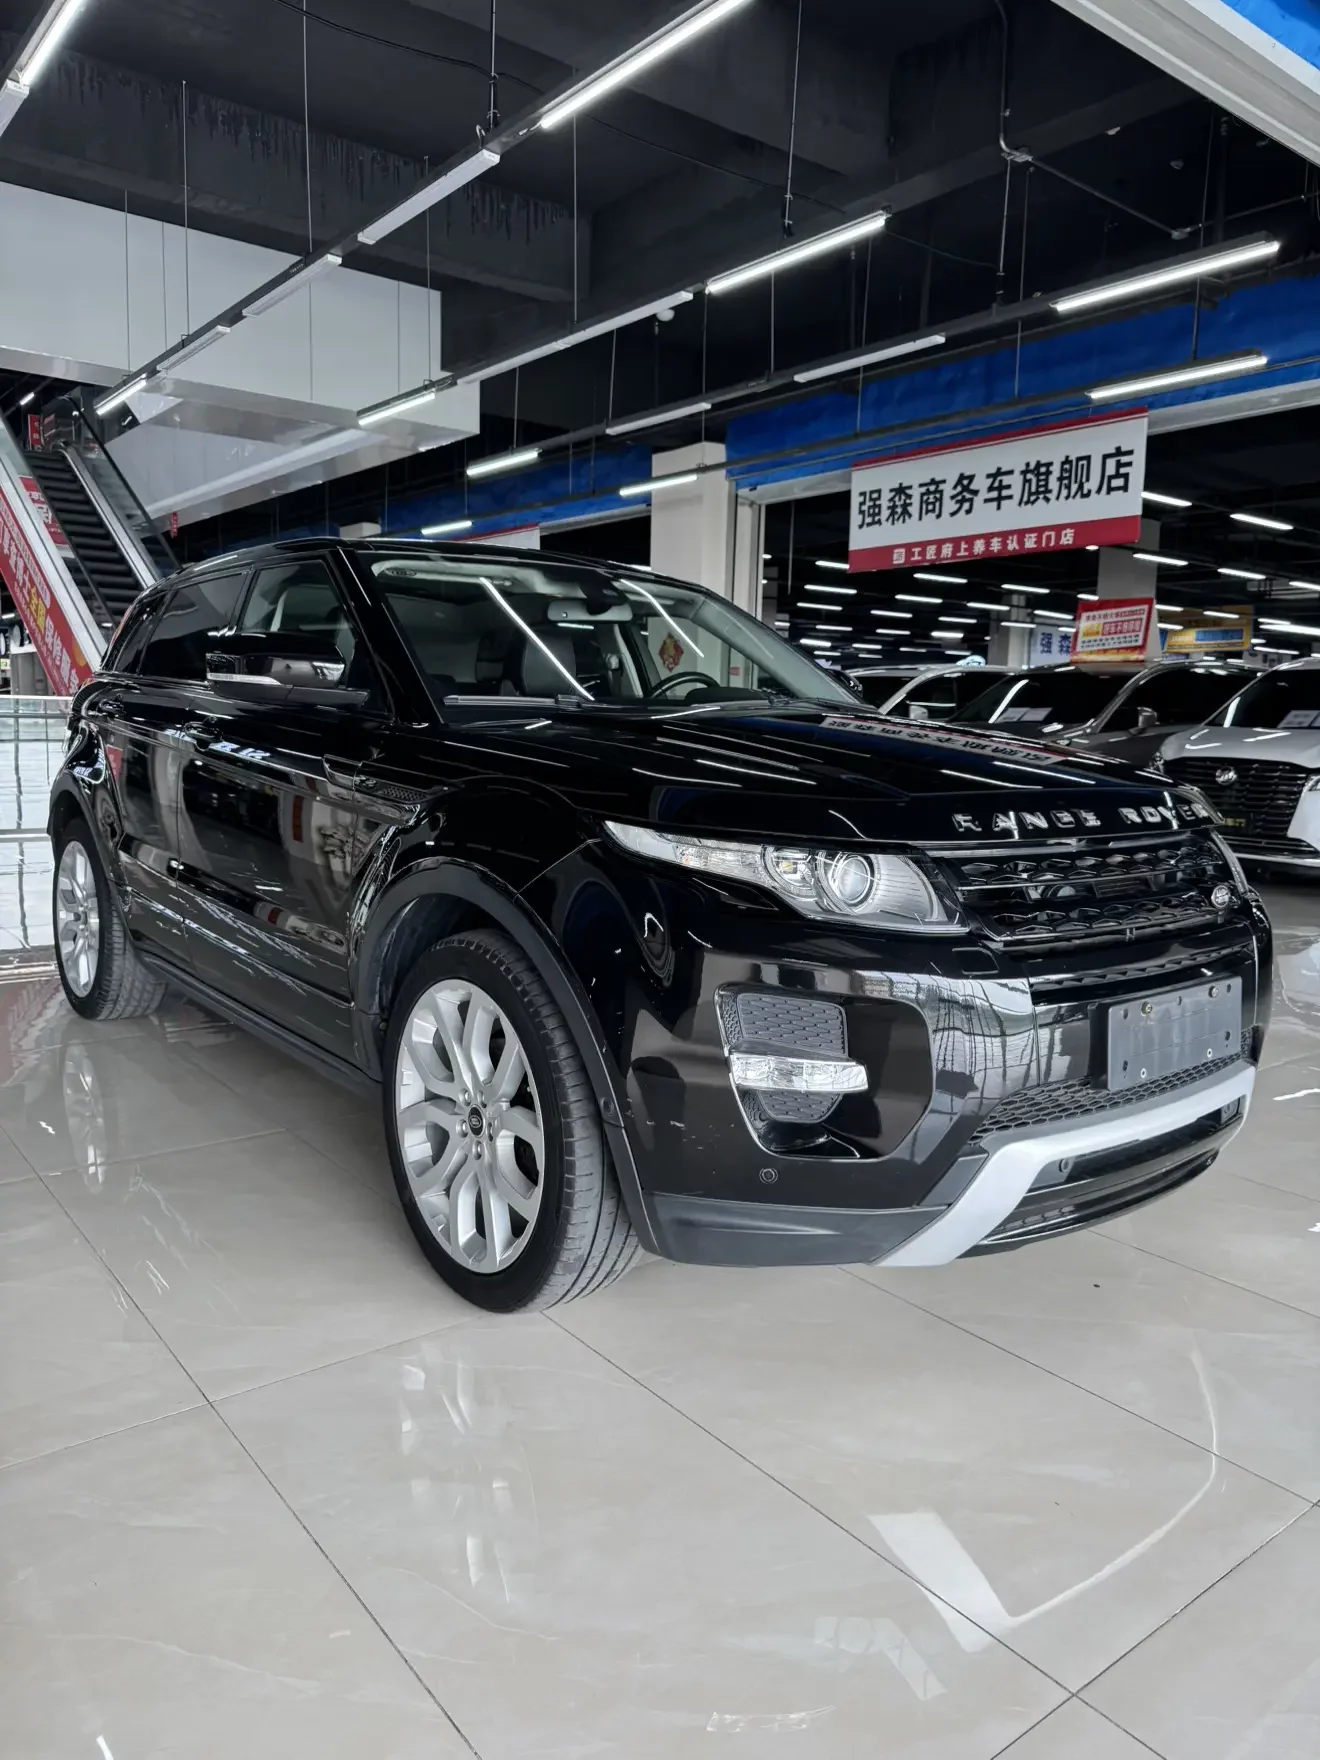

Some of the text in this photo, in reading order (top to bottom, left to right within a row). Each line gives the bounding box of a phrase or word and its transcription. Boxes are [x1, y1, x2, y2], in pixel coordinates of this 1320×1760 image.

[857, 445, 1135, 530] 强森商务车旗舰店
[952, 808, 1102, 832] RANGE
[1117, 803, 1210, 825] ROVER
